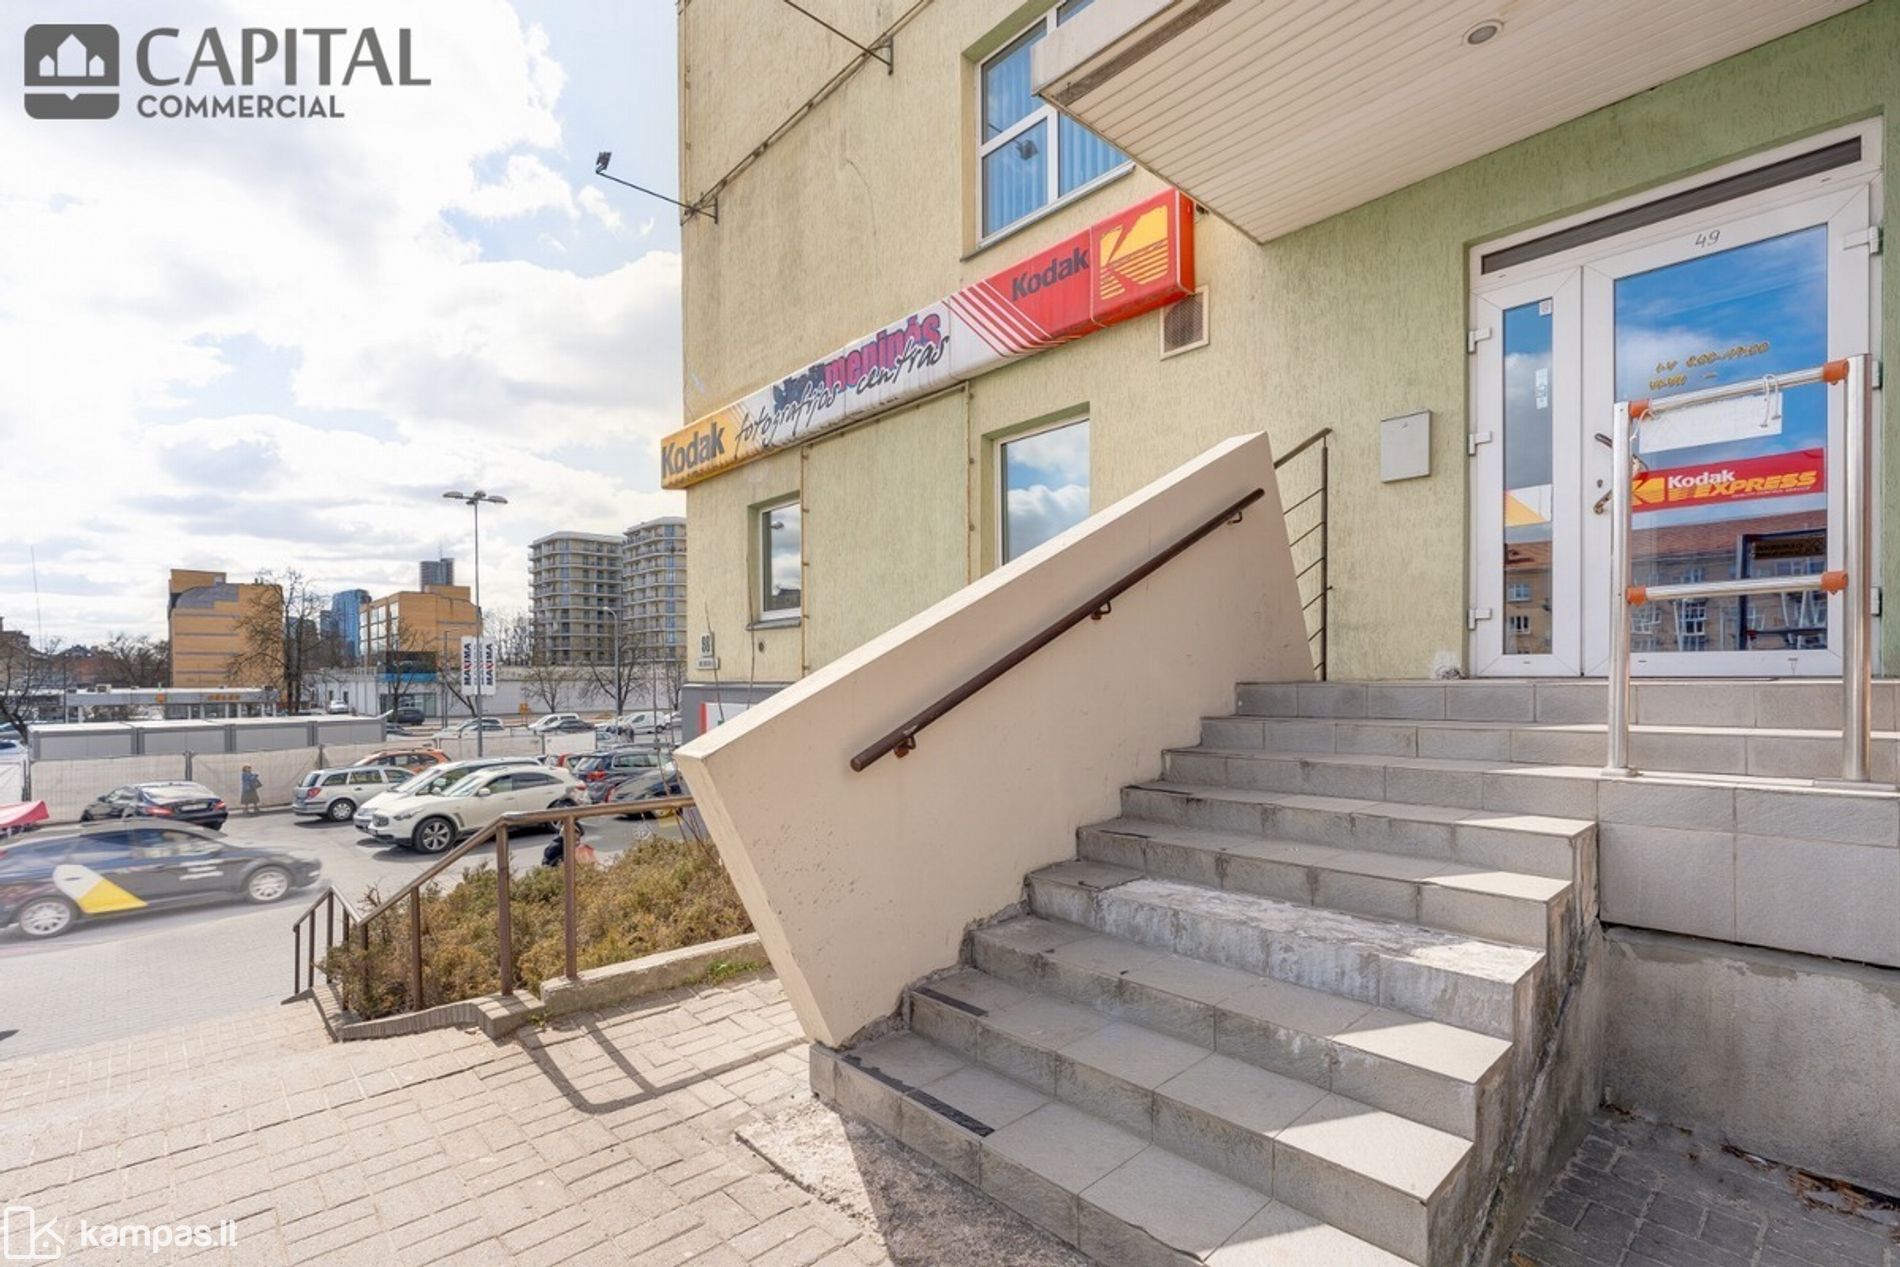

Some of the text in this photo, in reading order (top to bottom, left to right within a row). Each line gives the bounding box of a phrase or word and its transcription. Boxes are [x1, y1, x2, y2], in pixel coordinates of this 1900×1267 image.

[1695, 229, 1721, 248] 49
[1012, 247, 1089, 301] Kodak
[661, 422, 725, 478] Kodak
[1668, 469, 1735, 489] Kodak
[1694, 471, 1817, 498] EXPRESS
[463, 643, 472, 686] MAXIMA
[486, 643, 494, 686] MAXIMA
